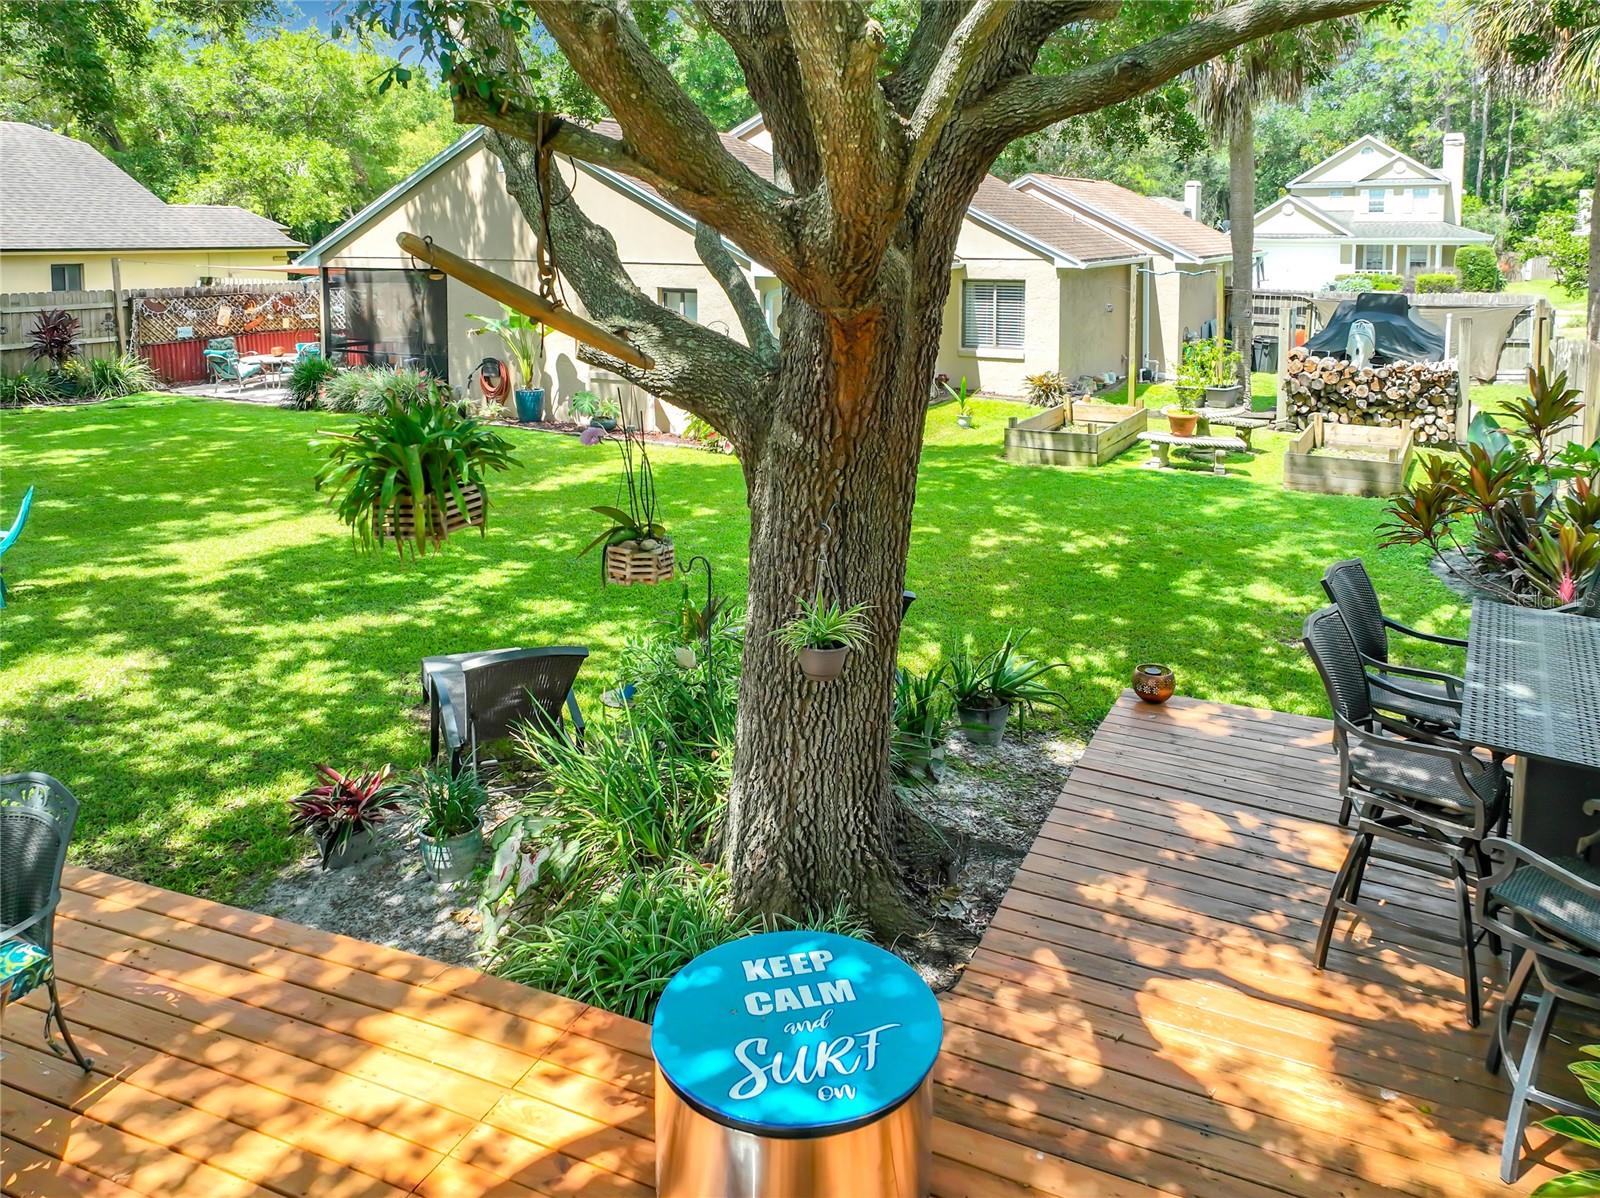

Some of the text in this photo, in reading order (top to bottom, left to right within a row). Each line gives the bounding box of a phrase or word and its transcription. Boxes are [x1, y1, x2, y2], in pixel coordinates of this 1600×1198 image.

[742, 950, 834, 982] KEEP
[744, 979, 856, 1016] CALM
[783, 1009, 834, 1034] and
[728, 1023, 901, 1100] SURF
[817, 1084, 856, 1101] on
